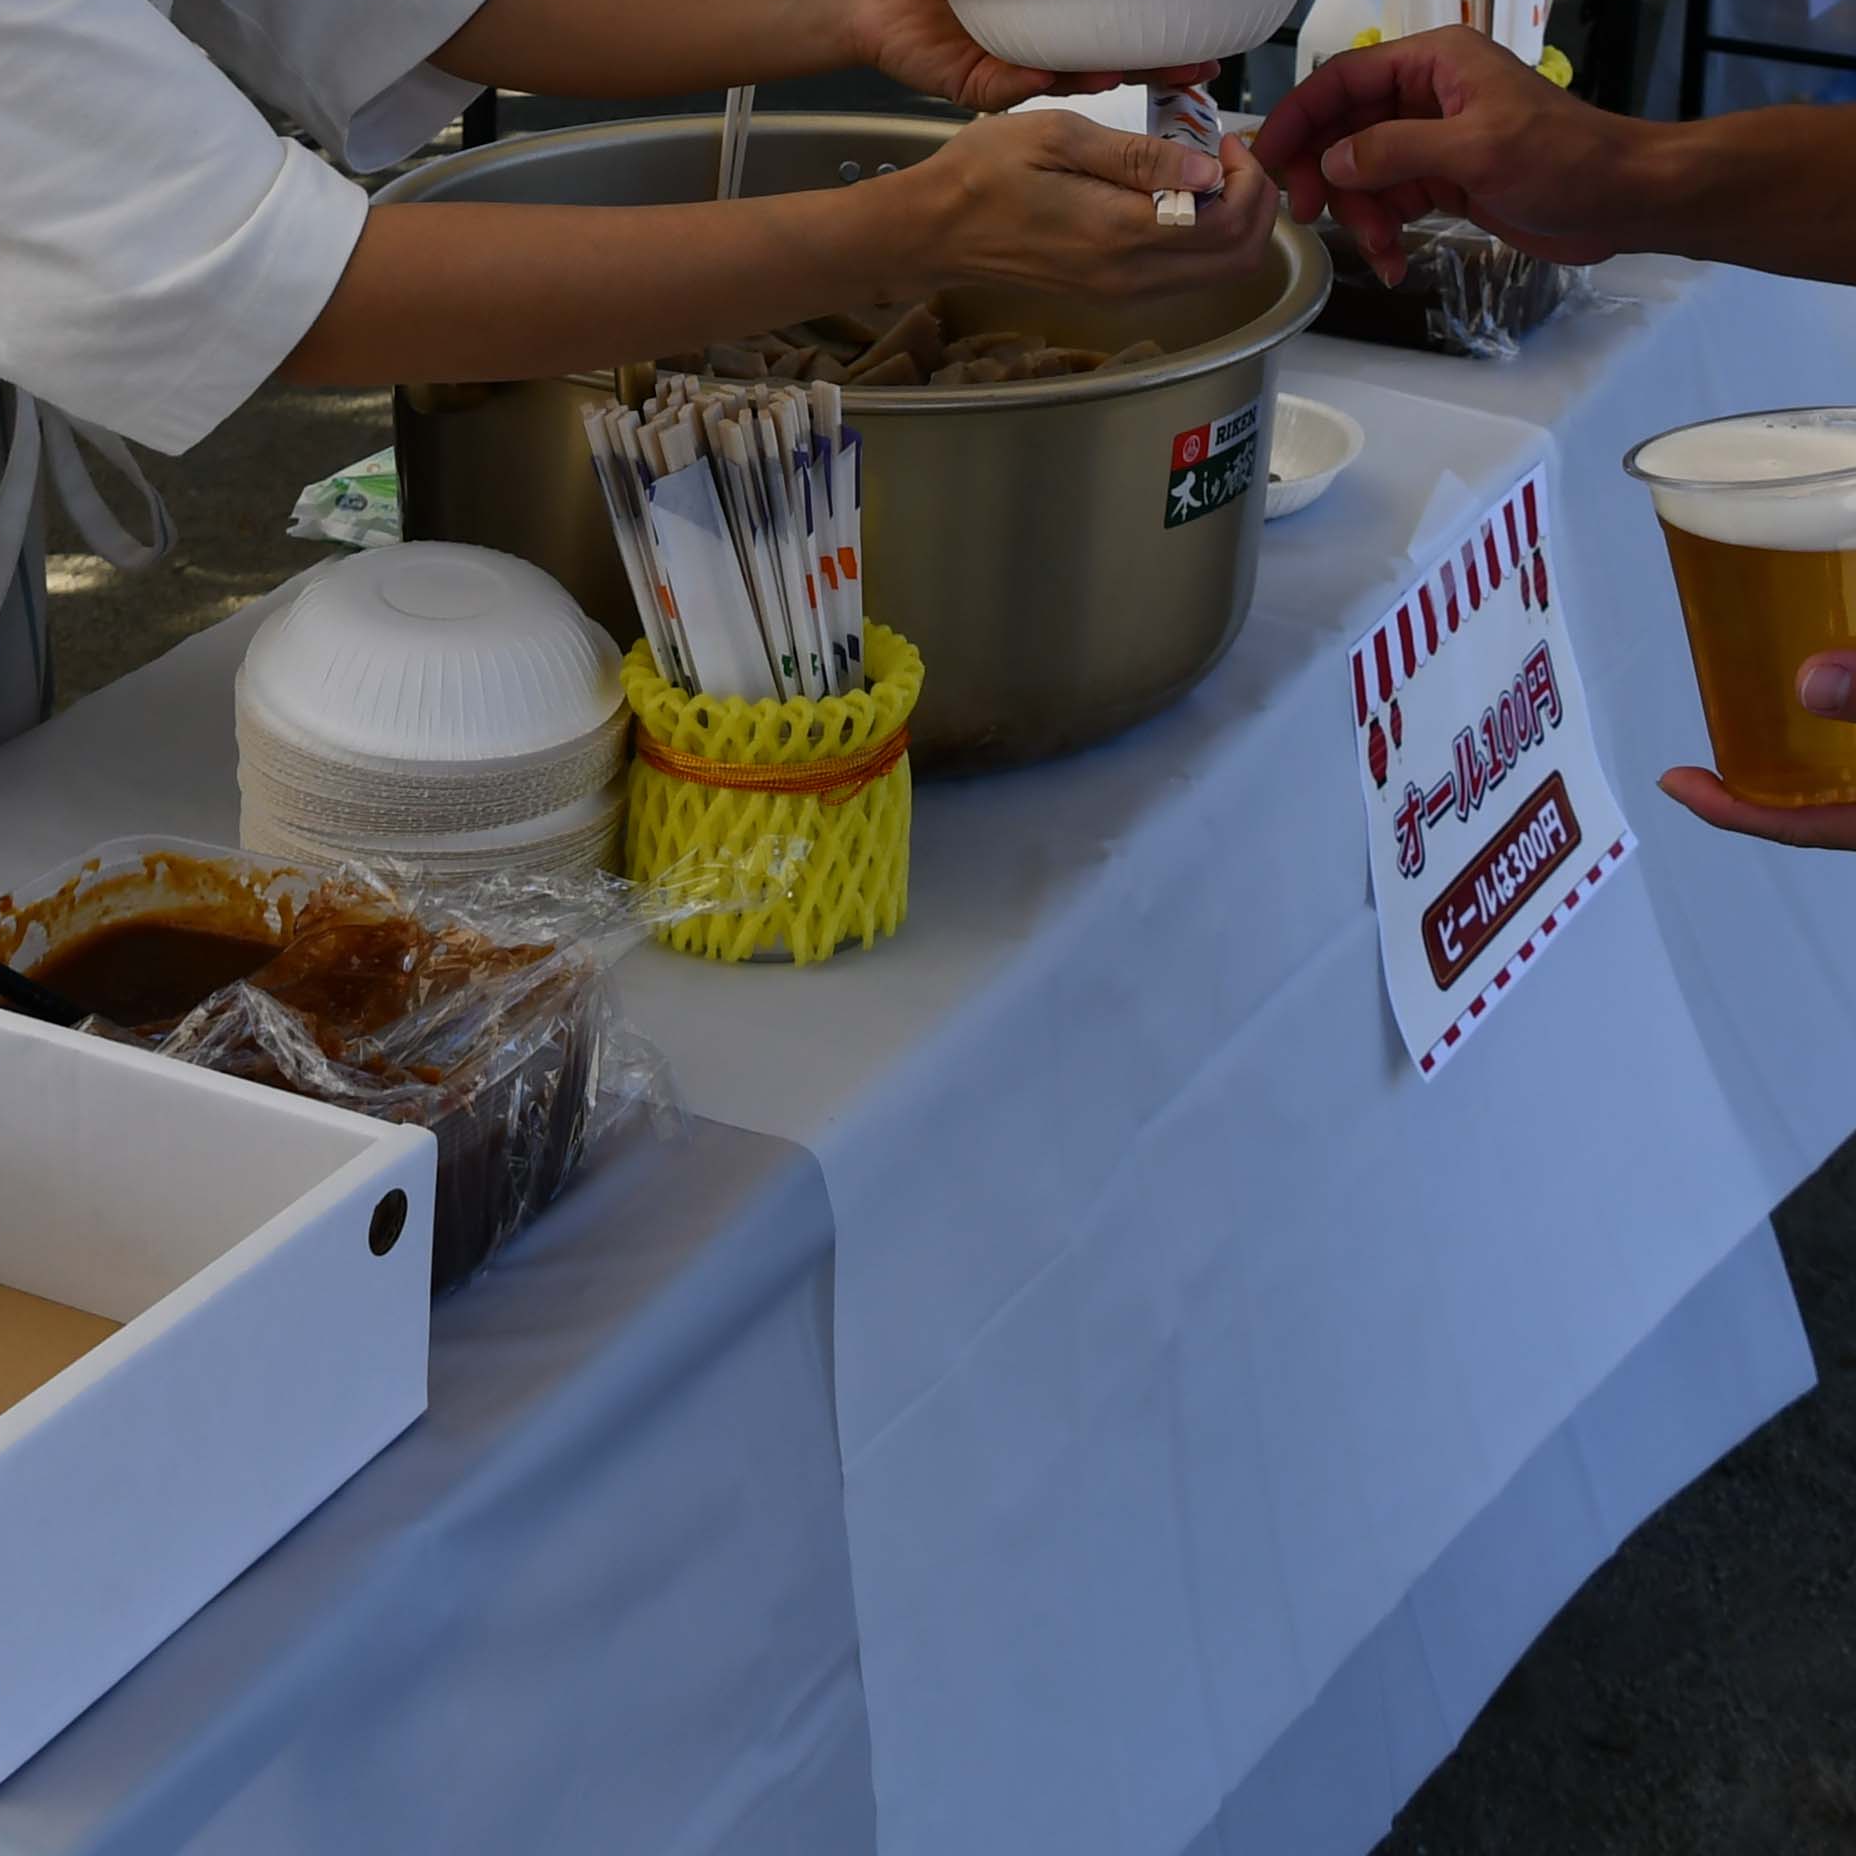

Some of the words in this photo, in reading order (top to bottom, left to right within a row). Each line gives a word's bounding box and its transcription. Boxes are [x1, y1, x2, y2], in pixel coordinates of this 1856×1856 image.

[1215, 405, 1257, 446] RIKEN
[1394, 639, 1562, 880] オール100円
[1437, 798, 1568, 963] ビールは300円
